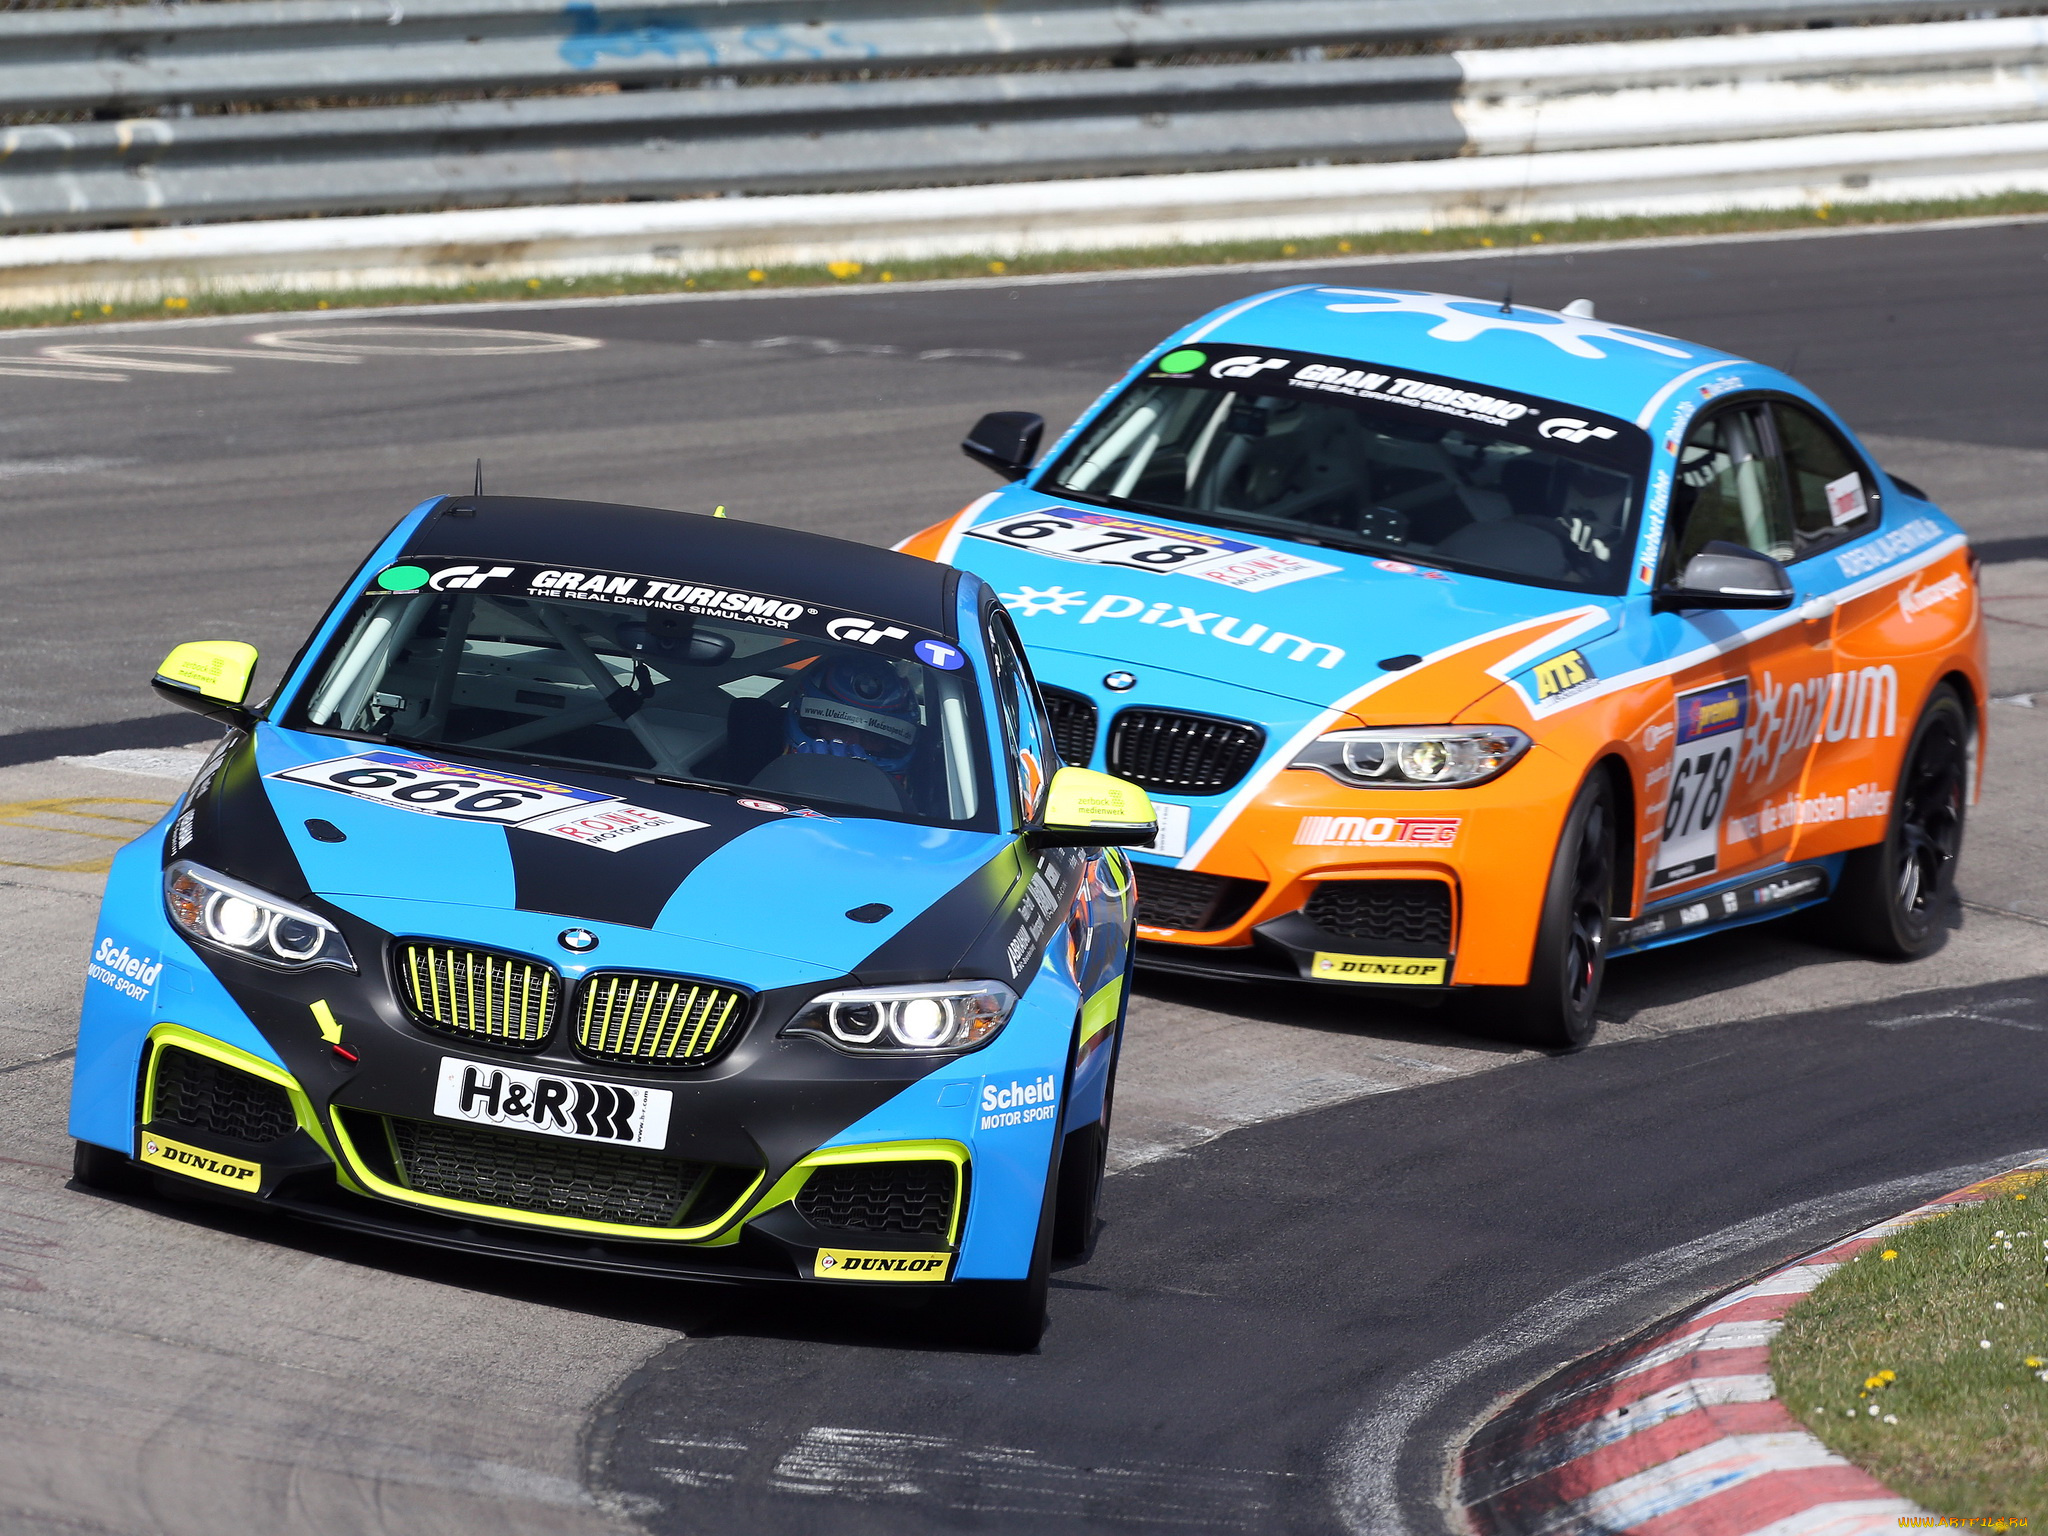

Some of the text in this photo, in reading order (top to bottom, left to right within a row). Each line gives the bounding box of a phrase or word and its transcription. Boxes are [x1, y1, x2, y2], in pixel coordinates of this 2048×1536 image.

[1294, 363, 1529, 421] GRAN TURISMO
[997, 519, 1209, 565] 678
[1206, 555, 1300, 582] ROWE
[527, 587, 789, 630] THE REAL DRIVING SIMULATOR
[531, 570, 804, 622] GRAN TURISMO
[1078, 594, 1346, 669] pixum
[924, 642, 957, 667] T
[1532, 650, 1588, 700] ATS
[329, 767, 543, 812] 666
[1663, 746, 1732, 842] 678
[555, 810, 661, 840] ROWE
[586, 825, 646, 844] MOTOR
[87, 962, 150, 1002] MOTOR SPORT
[95, 937, 164, 987] Scheid
[1339, 961, 1437, 976] DUNLOP
[980, 1075, 1056, 1112] Scheid
[636, 1090, 650, 1143] www.h-r.com
[980, 1104, 1056, 1131] MOTOR SPORT
[162, 1146, 254, 1180] DUNLOP
[840, 1257, 944, 1273] DUNLOP
